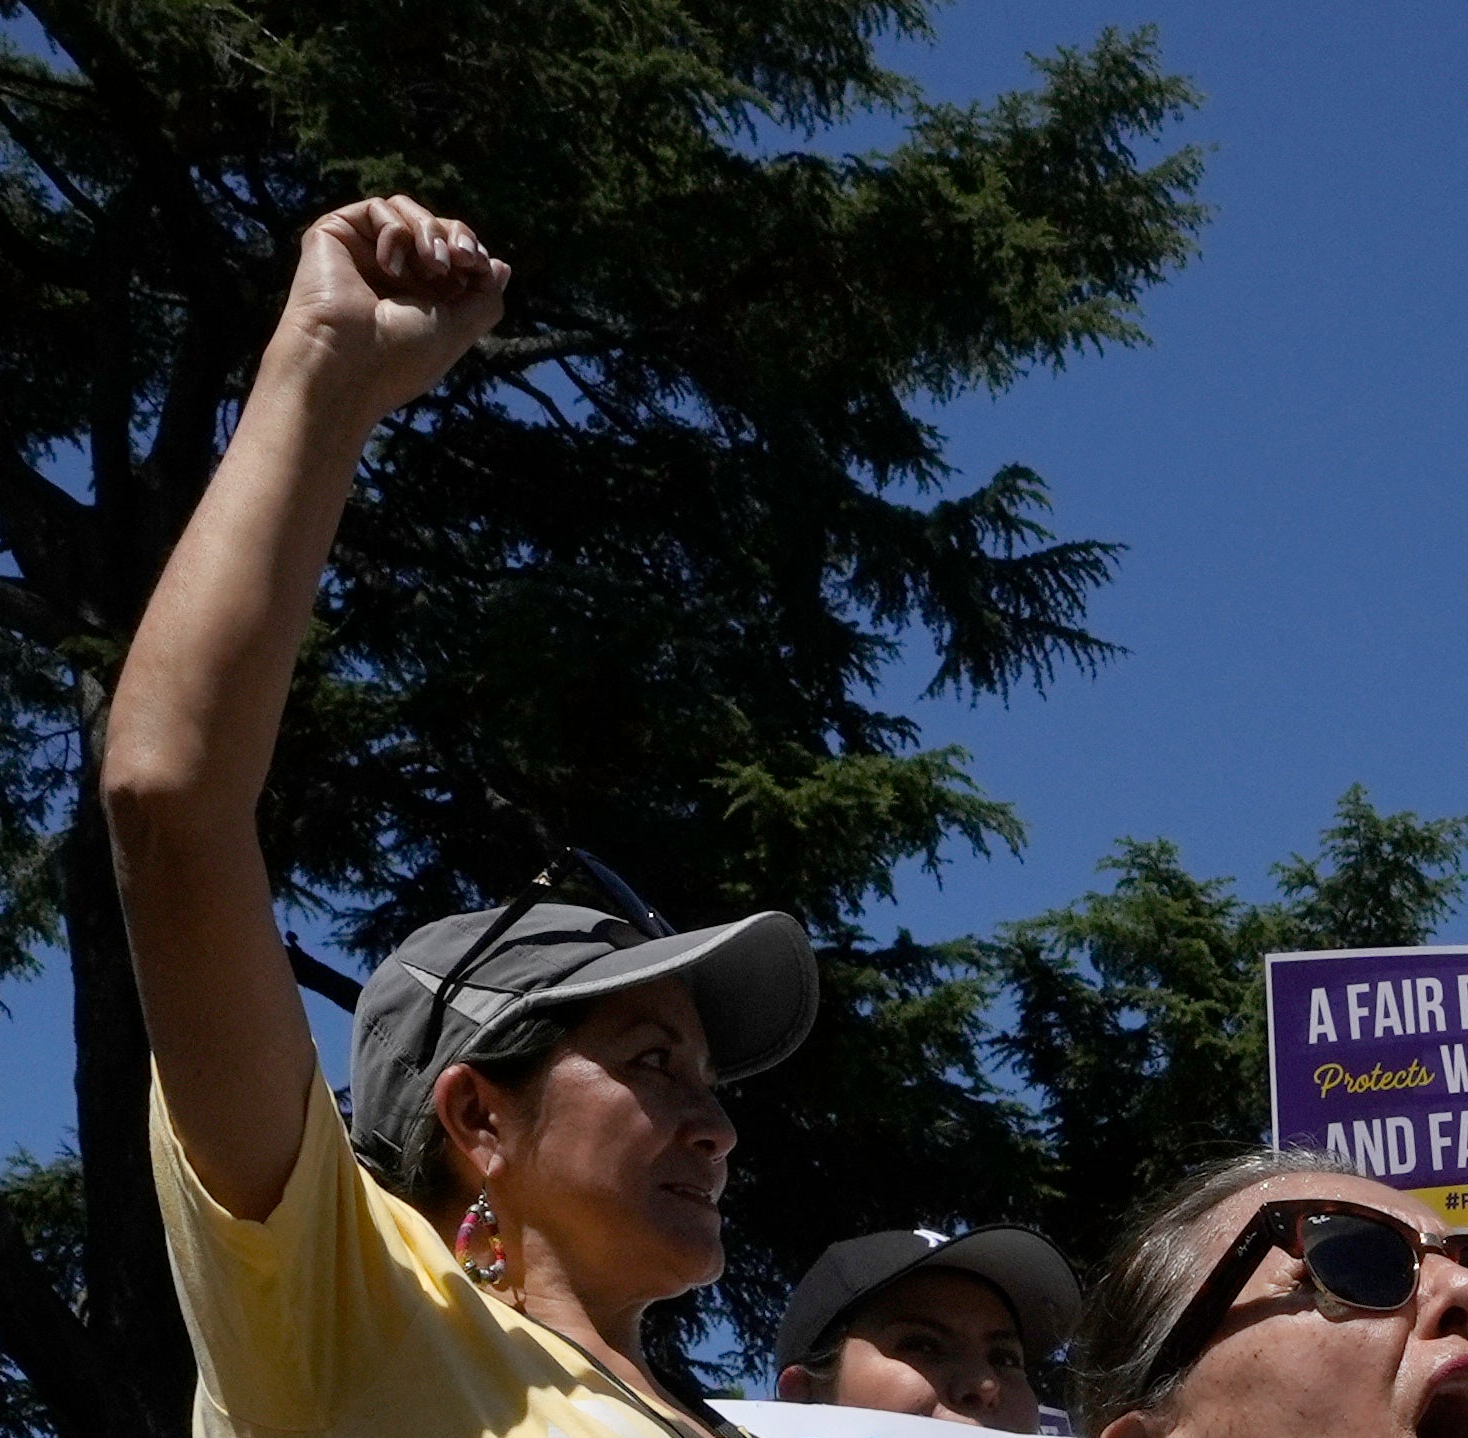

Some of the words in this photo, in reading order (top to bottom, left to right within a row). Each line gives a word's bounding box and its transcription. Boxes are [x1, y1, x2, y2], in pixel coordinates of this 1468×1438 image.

[1308, 988, 1338, 1044] A
[1347, 977, 1446, 1041] FAIR
[1314, 1058, 1435, 1098] Protects
[1326, 1116, 1417, 1177] AND
